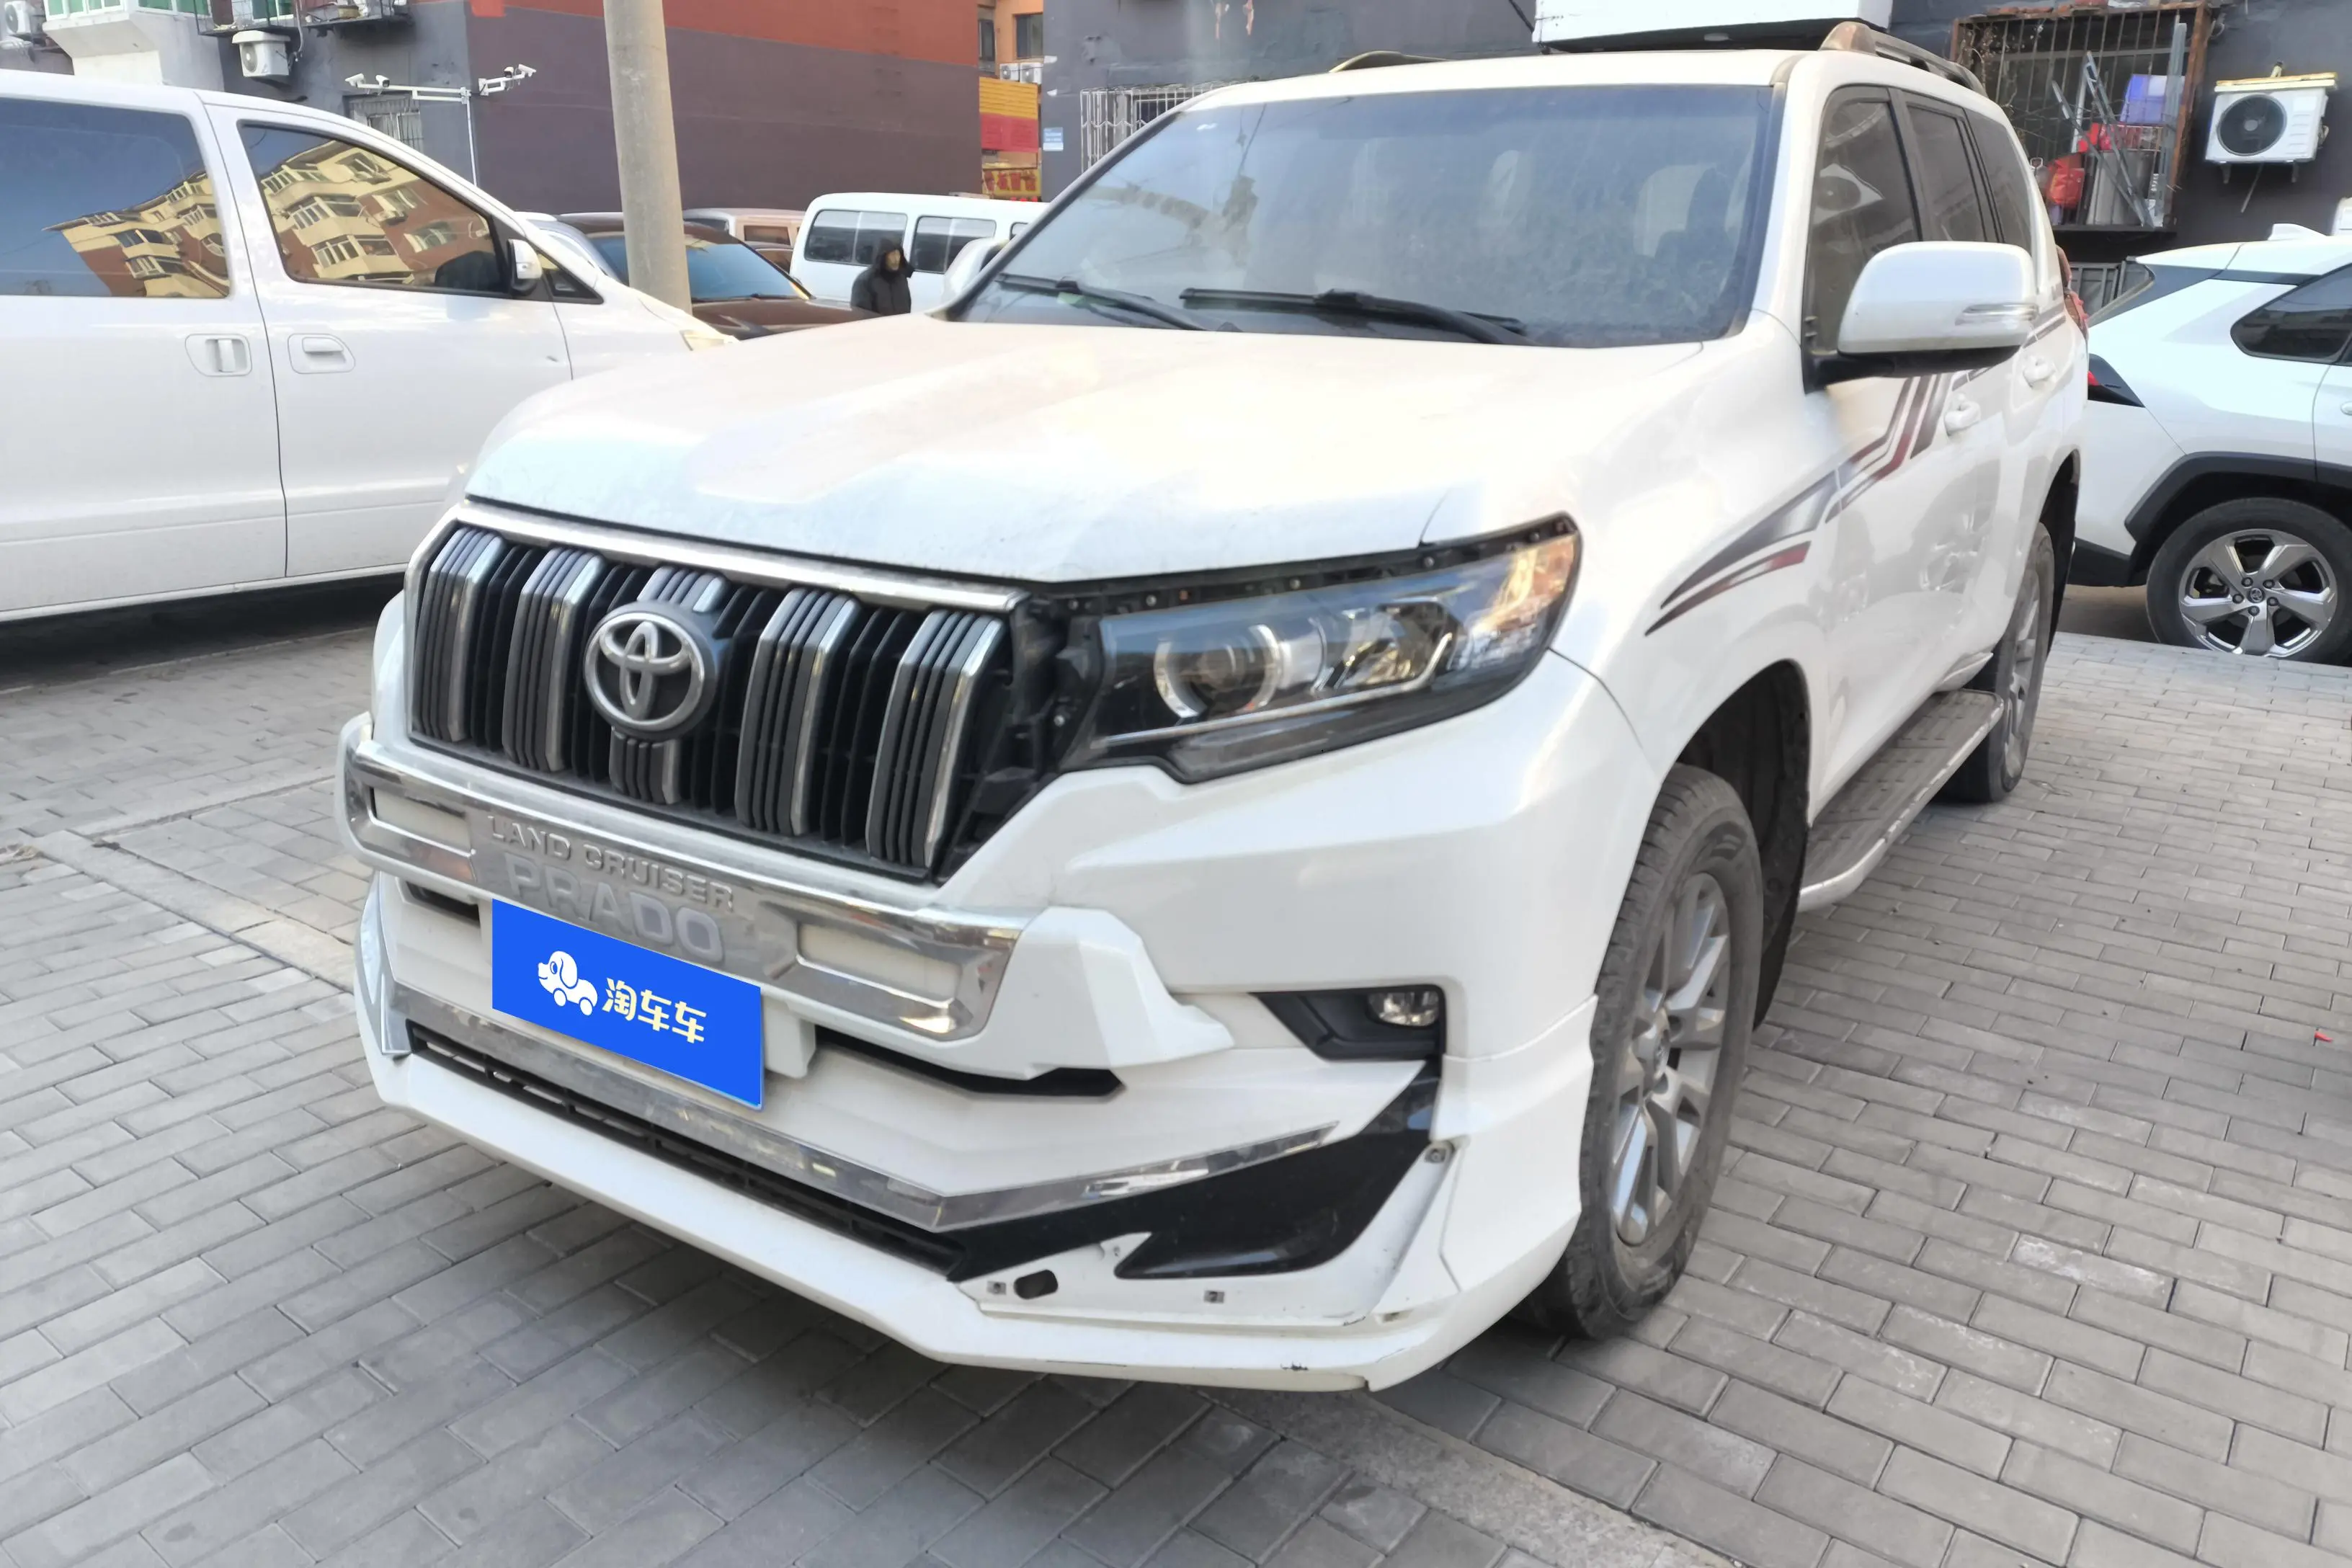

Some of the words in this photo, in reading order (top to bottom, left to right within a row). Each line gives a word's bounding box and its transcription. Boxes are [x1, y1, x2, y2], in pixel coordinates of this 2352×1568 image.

[488, 815, 571, 861] LAND
[582, 843, 734, 913] CRUISER
[504, 850, 725, 964] PRADO
